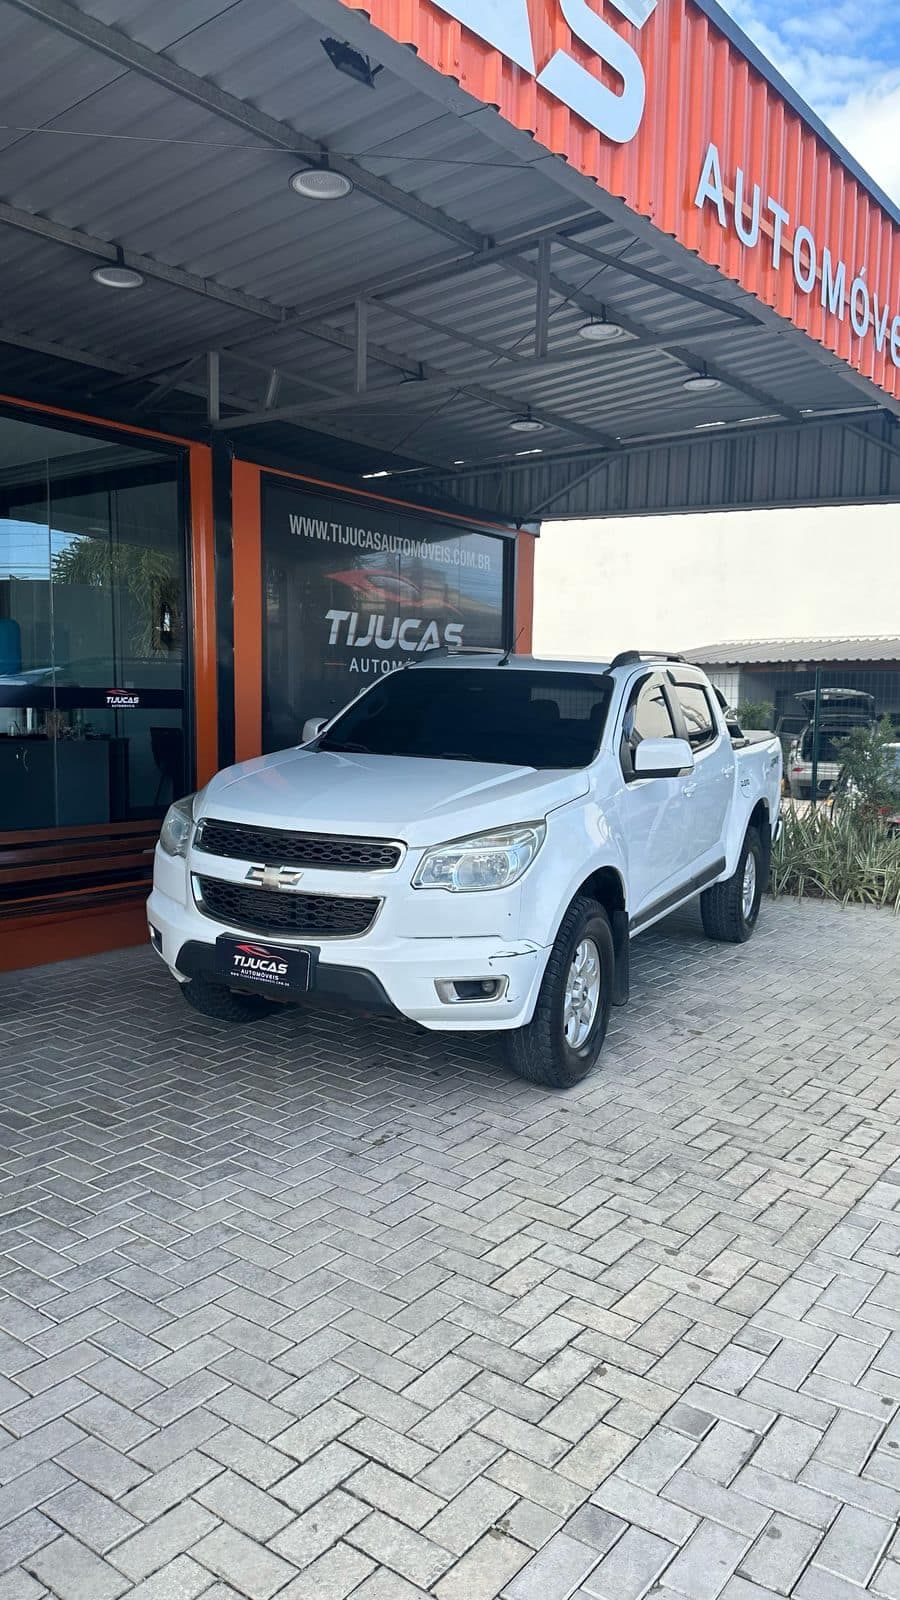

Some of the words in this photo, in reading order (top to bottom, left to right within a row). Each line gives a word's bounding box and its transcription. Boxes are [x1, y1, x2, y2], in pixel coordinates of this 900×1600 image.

[289, 513, 491, 571] WWW.TIJUCASAUTOMÓVEIS.COM.BR
[325, 609, 464, 652] TIJUCAS
[106, 696, 140, 704] TIJUCAS
[233, 955, 288, 975] TIJUCAS
